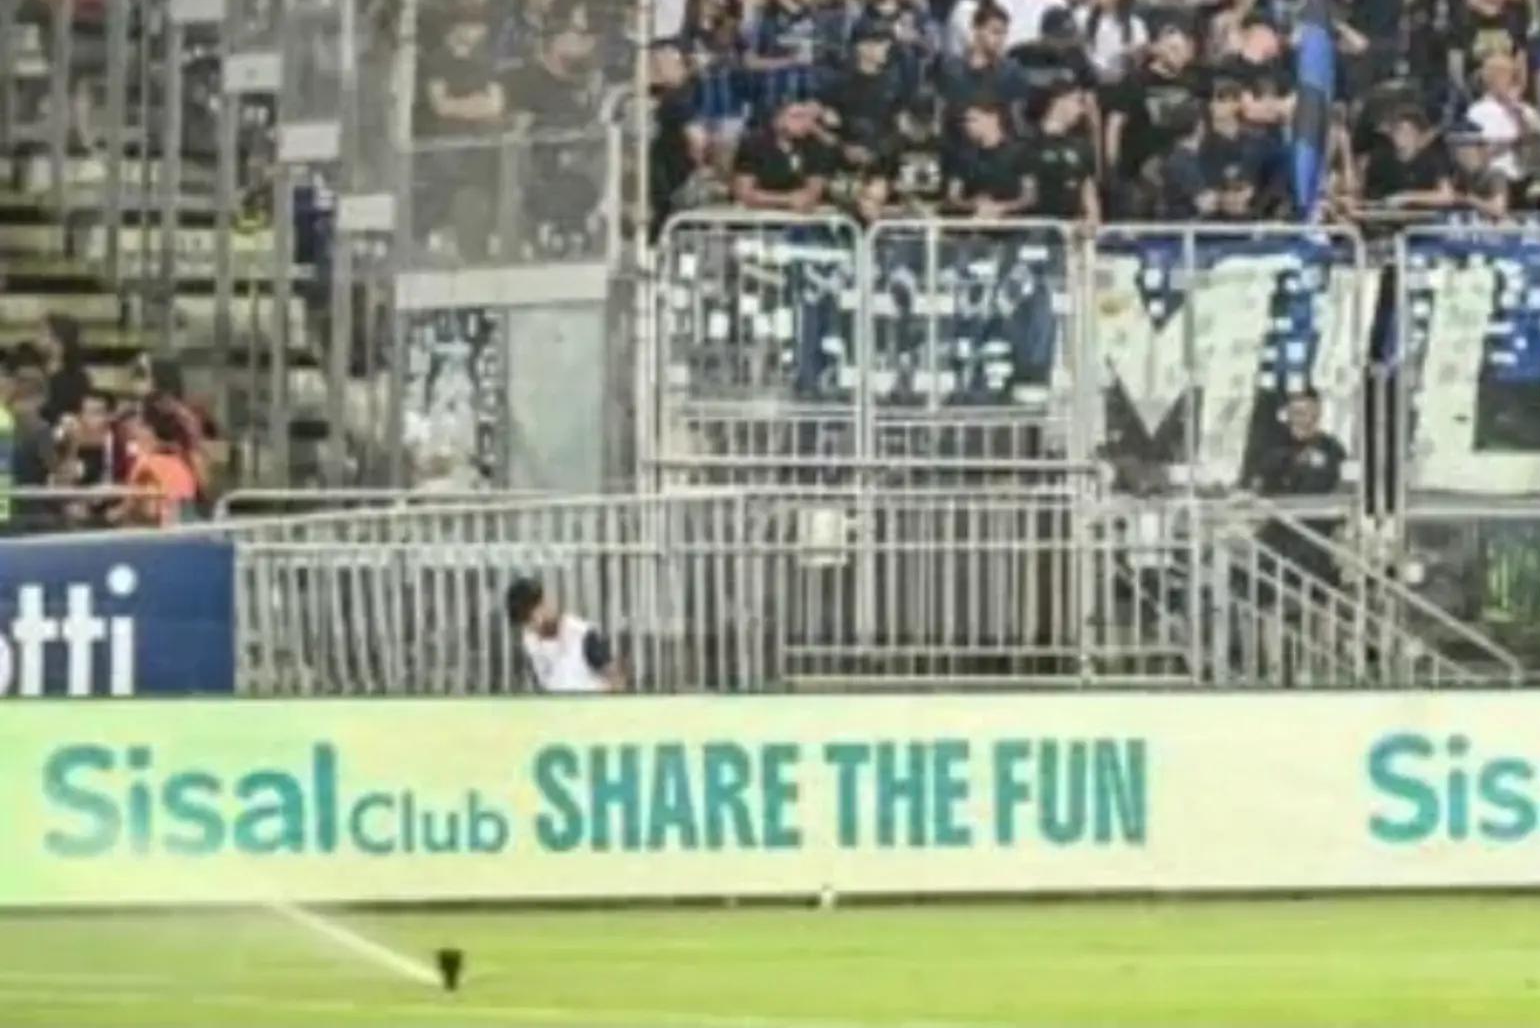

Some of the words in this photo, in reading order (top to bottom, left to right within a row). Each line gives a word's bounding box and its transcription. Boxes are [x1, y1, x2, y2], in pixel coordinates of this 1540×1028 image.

[42, 742, 338, 856] Sisal
[349, 785, 510, 855] Club
[532, 741, 804, 852] SHARE
[824, 739, 973, 848] THE
[992, 737, 1148, 846] FUN
